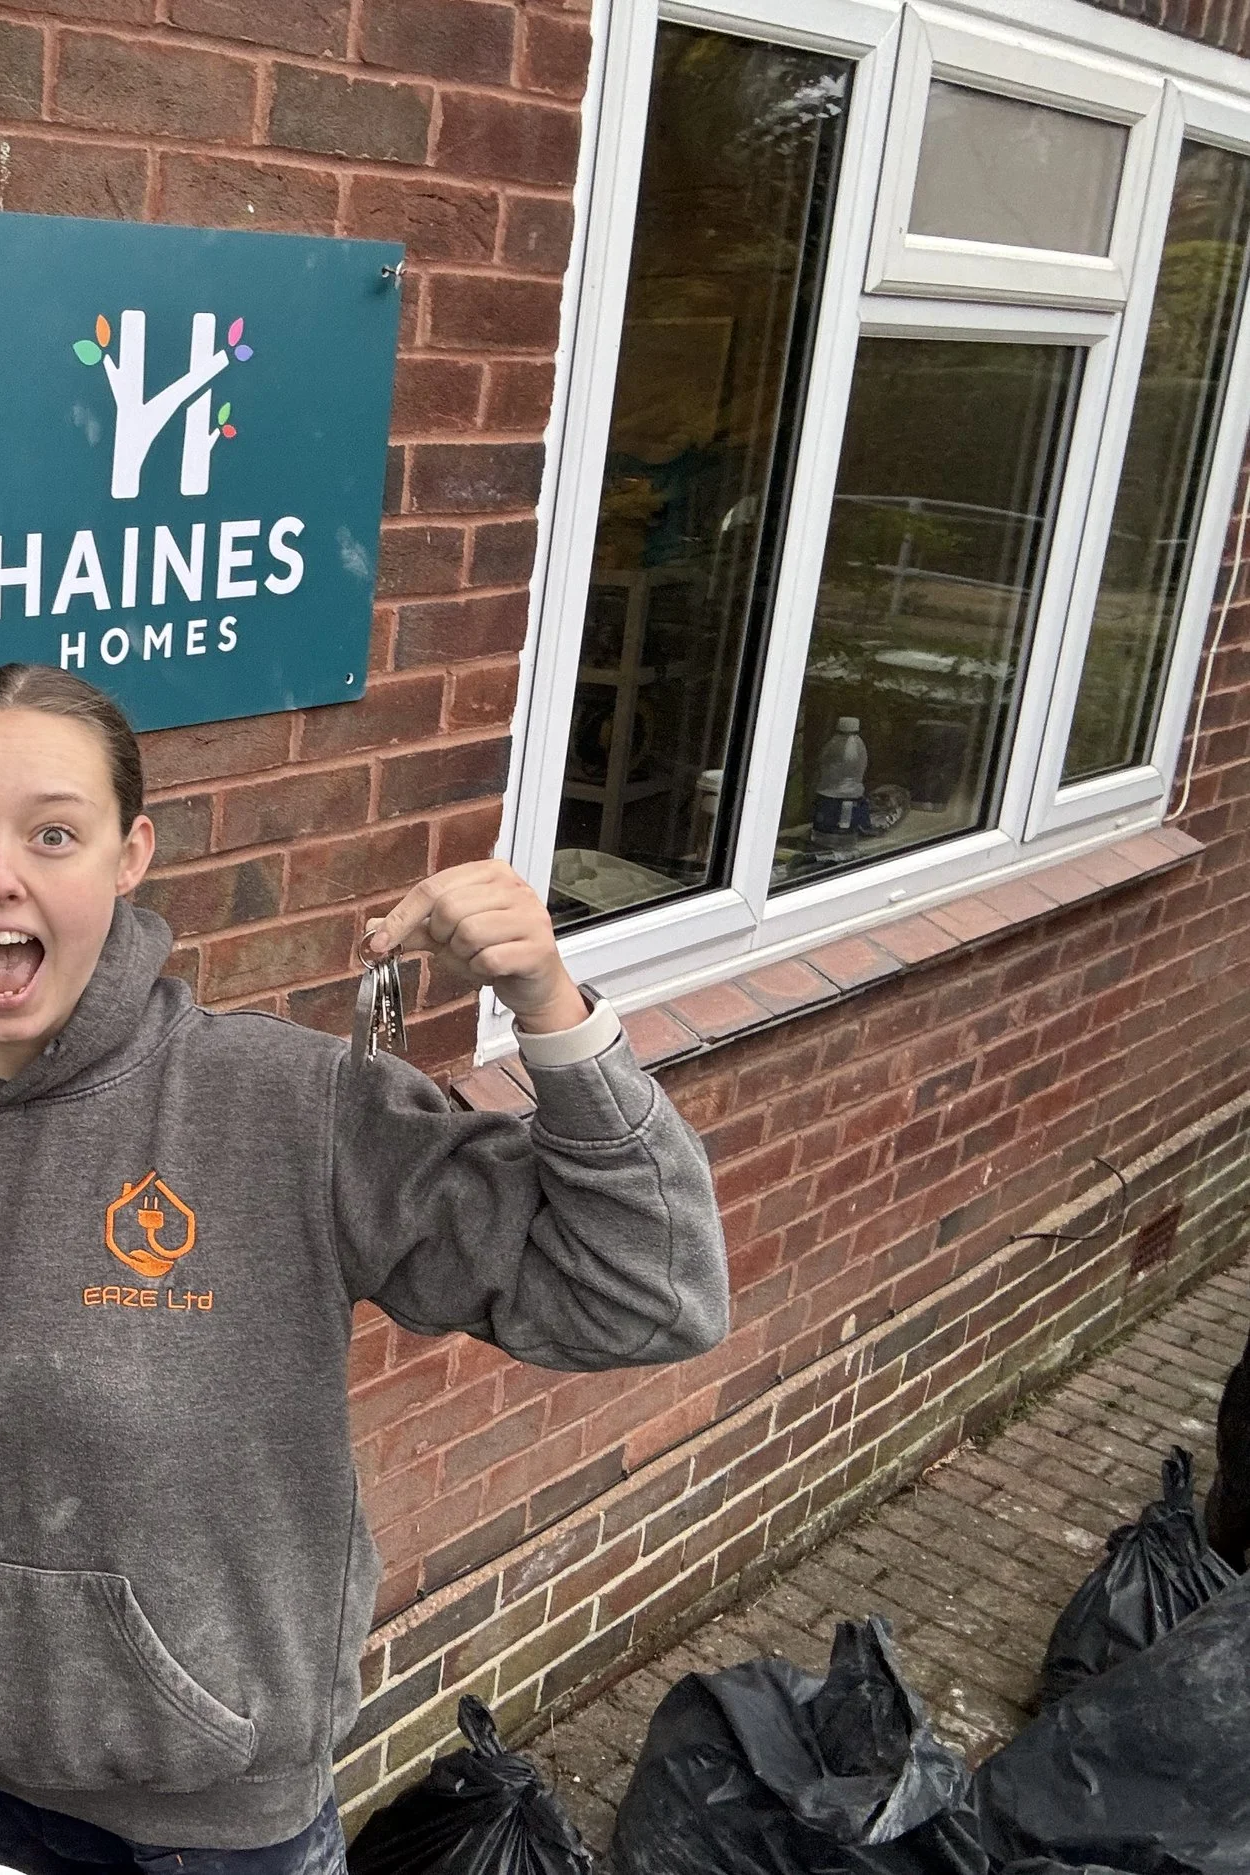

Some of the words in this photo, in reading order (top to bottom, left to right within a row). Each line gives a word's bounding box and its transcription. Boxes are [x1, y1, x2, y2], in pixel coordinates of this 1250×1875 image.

[60, 615, 238, 671] HOMES
[83, 1286, 159, 1308] EAZE
[167, 1288, 213, 1311] Ltd
